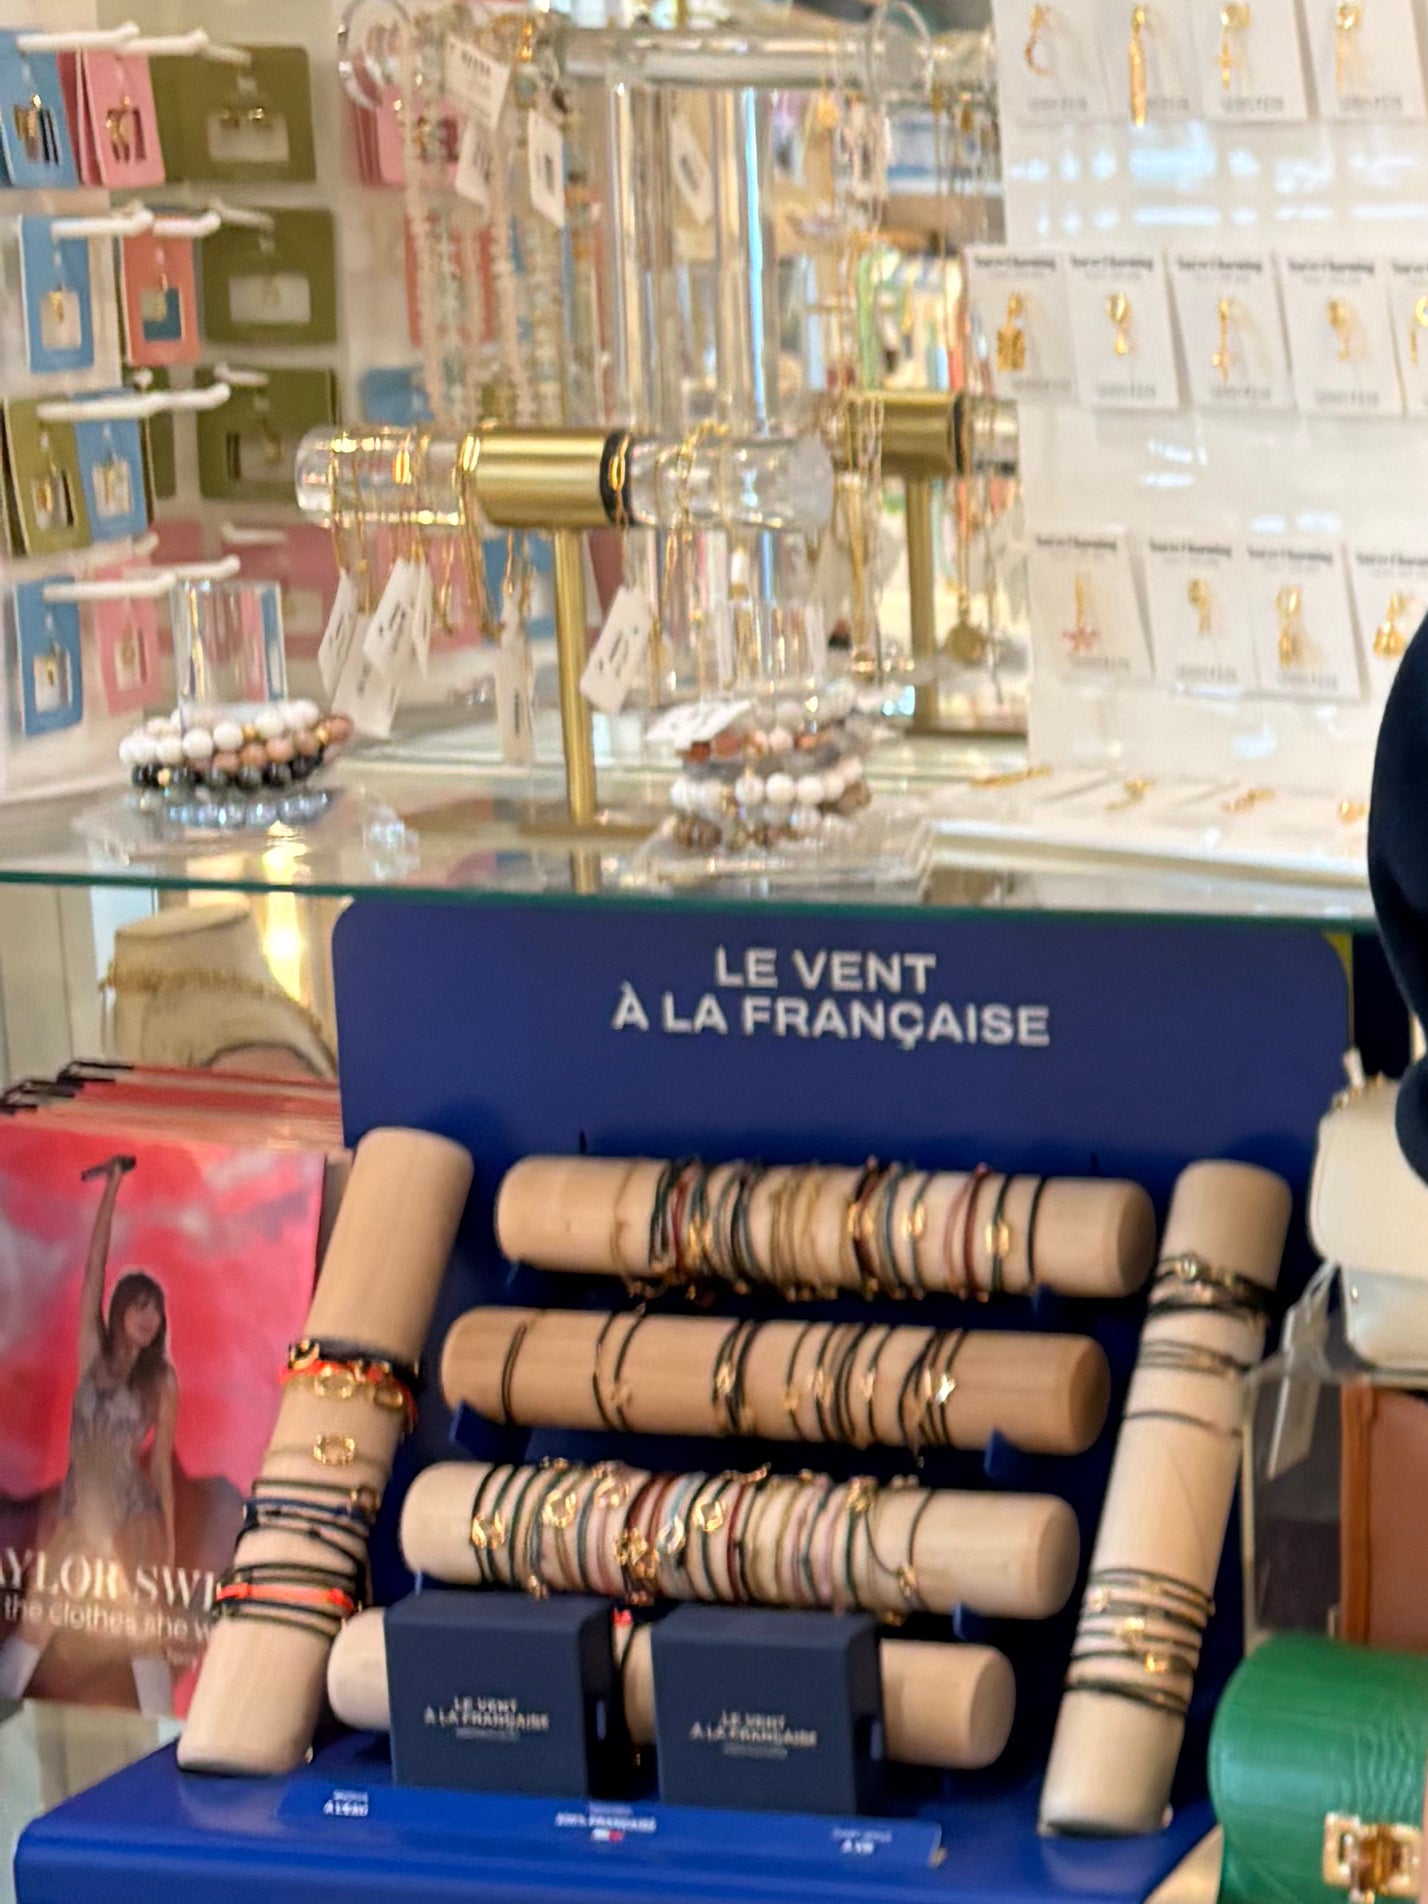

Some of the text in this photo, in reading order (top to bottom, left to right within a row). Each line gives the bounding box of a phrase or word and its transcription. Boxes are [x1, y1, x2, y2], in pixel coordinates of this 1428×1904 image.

[714, 945, 937, 994] LE VENT
[611, 980, 1051, 1051] À LA FRANÇAISE
